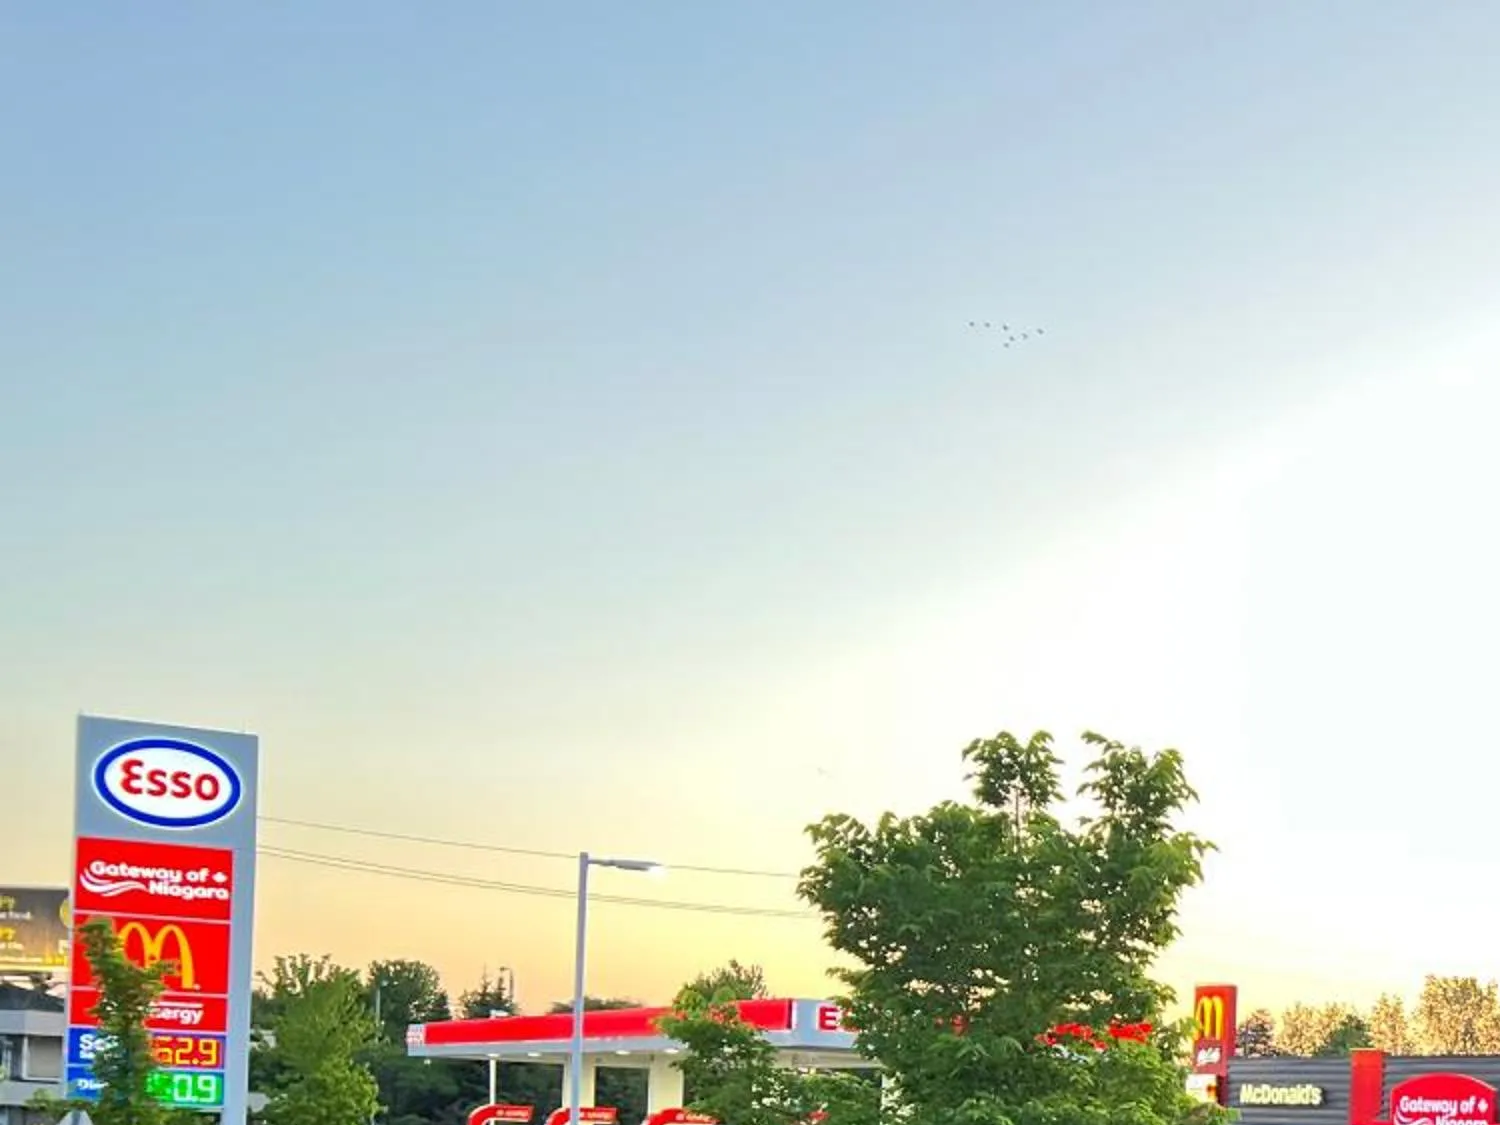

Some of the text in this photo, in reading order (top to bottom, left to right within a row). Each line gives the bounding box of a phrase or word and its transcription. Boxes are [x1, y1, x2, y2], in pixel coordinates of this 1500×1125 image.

[120, 758, 219, 801] Esso
[90, 861, 209, 882] Gateway of
[149, 880, 229, 900] Niagara
[151, 1034, 217, 1065] 62.9
[1239, 1083, 1323, 1105] McDonald's
[1399, 1096, 1477, 1116] Gateway of
